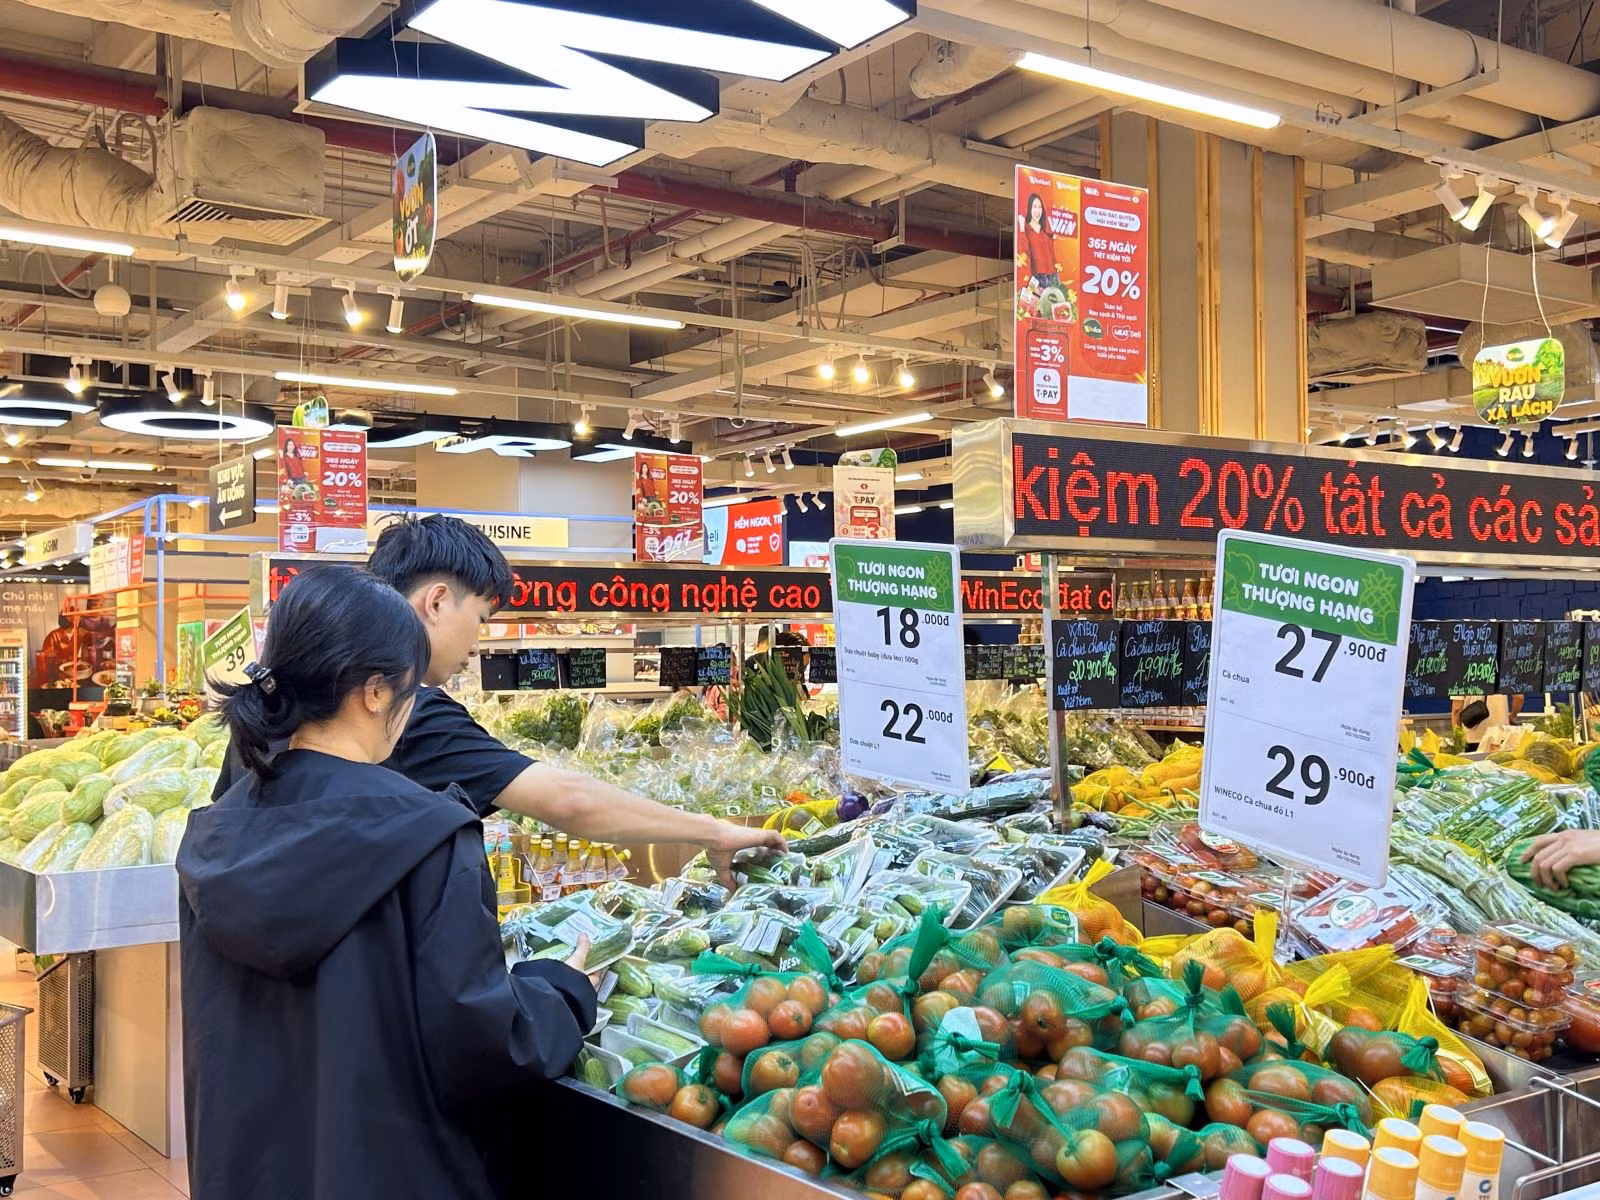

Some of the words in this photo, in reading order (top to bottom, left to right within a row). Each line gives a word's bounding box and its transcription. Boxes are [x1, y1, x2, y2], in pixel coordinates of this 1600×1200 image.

[1088, 237, 1107, 250] 365
[1109, 241, 1137, 254] NGÀY
[1082, 265, 1141, 299] 20%
[1041, 344, 1065, 363] 3%
[1498, 383, 1536, 403] RAU
[1511, 398, 1553, 417] LÁCH
[322, 471, 363, 487] 20%
[669, 491, 700, 505] 20%
[853, 496, 875, 504] T-PAY
[1014, 443, 1159, 537] kiệm
[1178, 457, 1306, 534] 20%
[1321, 459, 1387, 538] tất
[1400, 472, 1454, 543] cả
[1468, 484, 1543, 546] các
[857, 561, 885, 577] TƯƠI
[888, 564, 925, 580] NGON
[1259, 562, 1300, 586] TƯƠI
[1304, 571, 1360, 597] NGON
[3, 591, 26, 601] Chủ
[510, 572, 577, 613] ờng
[589, 575, 670, 613] công
[682, 575, 759, 613] nghệ
[769, 585, 821, 609] cao
[1058, 582, 1093, 615] đạt
[848, 578, 899, 597] THƯỢNG
[901, 583, 937, 600] HẠNG
[1241, 583, 1316, 613] THƯỢNG
[1319, 600, 1375, 625] HẠNG
[904, 656, 918, 665] 500g
[1232, 673, 1250, 684] chua
[1214, 785, 1243, 801] WINECO
[1254, 799, 1272, 811] chua
[1284, 808, 1294, 818] L1
